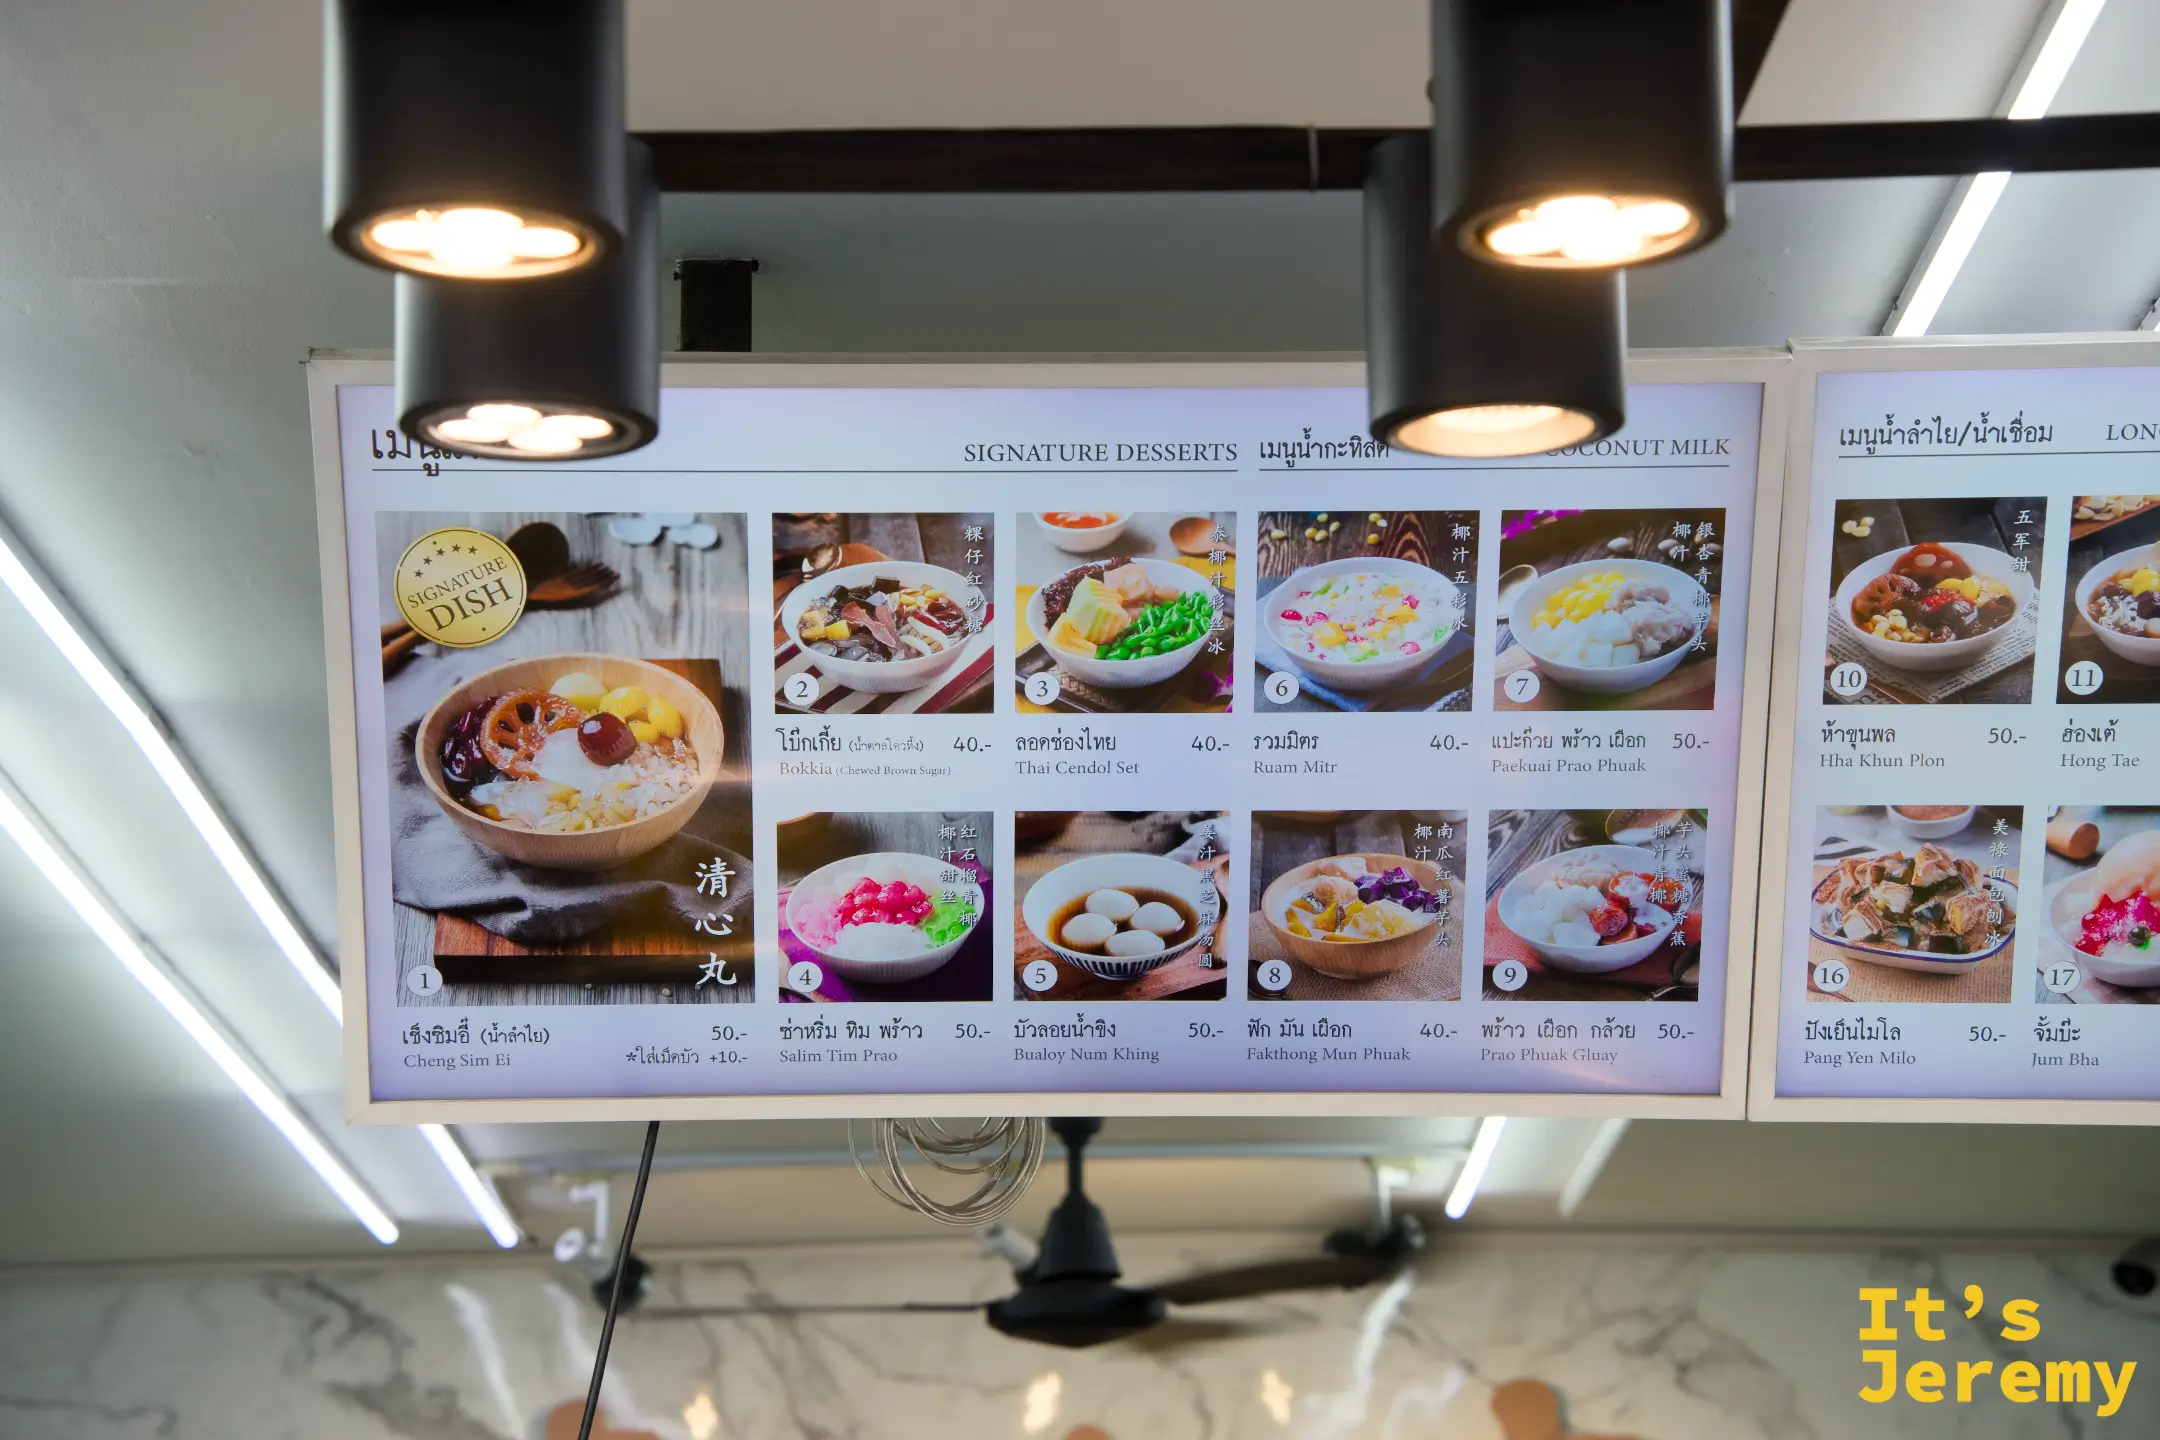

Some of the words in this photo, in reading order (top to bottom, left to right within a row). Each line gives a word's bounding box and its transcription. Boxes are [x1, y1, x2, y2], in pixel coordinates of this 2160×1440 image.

[2105, 424, 2160, 440] LON
[964, 443, 1109, 462] SIGNATURE
[1116, 443, 1238, 462] DESSERTS
[1670, 438, 1731, 455] MILK
[1672, 521, 1691, 562] 椰汁
[2012, 510, 2033, 572] 五军甜
[407, 555, 508, 610] SIGNATURE
[425, 578, 514, 632] DISH
[1837, 670, 1861, 688] 10
[2072, 669, 2095, 687] 11
[796, 680, 809, 697] 2
[1036, 680, 1049, 698] 3
[1275, 679, 1288, 698] 6
[1517, 678, 1529, 696] 7
[1015, 727, 1116, 751] ลอดช่องไทย
[1561, 728, 1601, 749] พร้าว
[1610, 729, 1646, 748] เผือก
[1821, 720, 1896, 750] ห้าขุนพล
[1988, 728, 2027, 744] 50.-
[2062, 718, 2119, 743] ฮ่องเต้
[953, 736, 992, 753] 40.-
[1191, 735, 1230, 751] 40.-
[1254, 730, 1319, 750] รวมมิตร
[1429, 734, 1469, 750] 40.-
[1672, 733, 1710, 749] 50.-
[1015, 761, 1050, 774] Thai
[1056, 761, 1111, 774] Cendol
[1116, 761, 1139, 774] Set
[1253, 761, 1297, 774] Ruam
[1303, 760, 1337, 774] Mitr
[1492, 759, 1551, 772] Paekuai
[1557, 759, 1592, 772] Prao
[1597, 759, 1647, 772] Phuak
[1820, 754, 1853, 767] Hha
[1859, 754, 1903, 767] Khun
[1909, 754, 1945, 767] Plon
[2061, 753, 2106, 771] Hong
[2112, 753, 2140, 767] Tae
[779, 762, 832, 775] Bokkia
[836, 766, 880, 777] (Chewed
[884, 766, 916, 775] Brown
[919, 766, 951, 777] Sugar)
[1414, 823, 1432, 862] 椰汁
[694, 856, 737, 988] 清心丸
[419, 973, 429, 989] 1
[799, 969, 812, 986] 4
[1035, 968, 1046, 985] 5
[1268, 966, 1281, 984] 8
[1504, 966, 1516, 984] 9
[1820, 967, 1844, 984] 16
[2049, 969, 2075, 986] 17
[711, 1025, 747, 1041] 50.-
[846, 1021, 870, 1039] ทิม
[879, 1017, 923, 1039] พร้าว
[955, 1024, 990, 1039] 50.-
[1014, 1013, 1116, 1038] บัวลอยน้ำขิง
[1188, 1023, 1223, 1038] 50.-
[1247, 1018, 1271, 1038] ฟัก
[1280, 1018, 1304, 1038] มัน
[1312, 1017, 1352, 1038] เผือก
[1420, 1023, 1457, 1038] 40.-
[1481, 1016, 1525, 1039] พร้าว
[1538, 1018, 1578, 1038] เผือก
[1591, 1016, 1636, 1039] กล้วย
[1658, 1024, 1694, 1039] 50.-
[1805, 1017, 1901, 1041] ปังเย็นไมโล
[1969, 1026, 2006, 1042] 50.-
[404, 1054, 456, 1070] Cheng
[460, 1054, 489, 1067] Sim
[495, 1053, 511, 1066] Ei
[709, 1051, 747, 1063] +10.-
[780, 1049, 821, 1062] Salim
[826, 1049, 858, 1062] Tim
[863, 1049, 898, 1062] Prao
[1014, 1047, 1065, 1064] Bualoy
[1070, 1047, 1107, 1061] Num
[1113, 1047, 1160, 1064] Khing
[1246, 1047, 1318, 1064] Fakthong
[1322, 1047, 1357, 1060] Mun
[1363, 1047, 1411, 1060] Phuak
[1481, 1048, 1515, 1061] Prao
[1520, 1048, 1568, 1061] Phuak
[1573, 1048, 1618, 1065] Gluay
[1804, 1051, 1842, 1068] Pang
[1846, 1051, 1874, 1064] Yen
[1879, 1051, 1916, 1065] Milo
[2031, 1053, 2063, 1068] Jum
[2069, 1053, 2099, 1066] Bha
